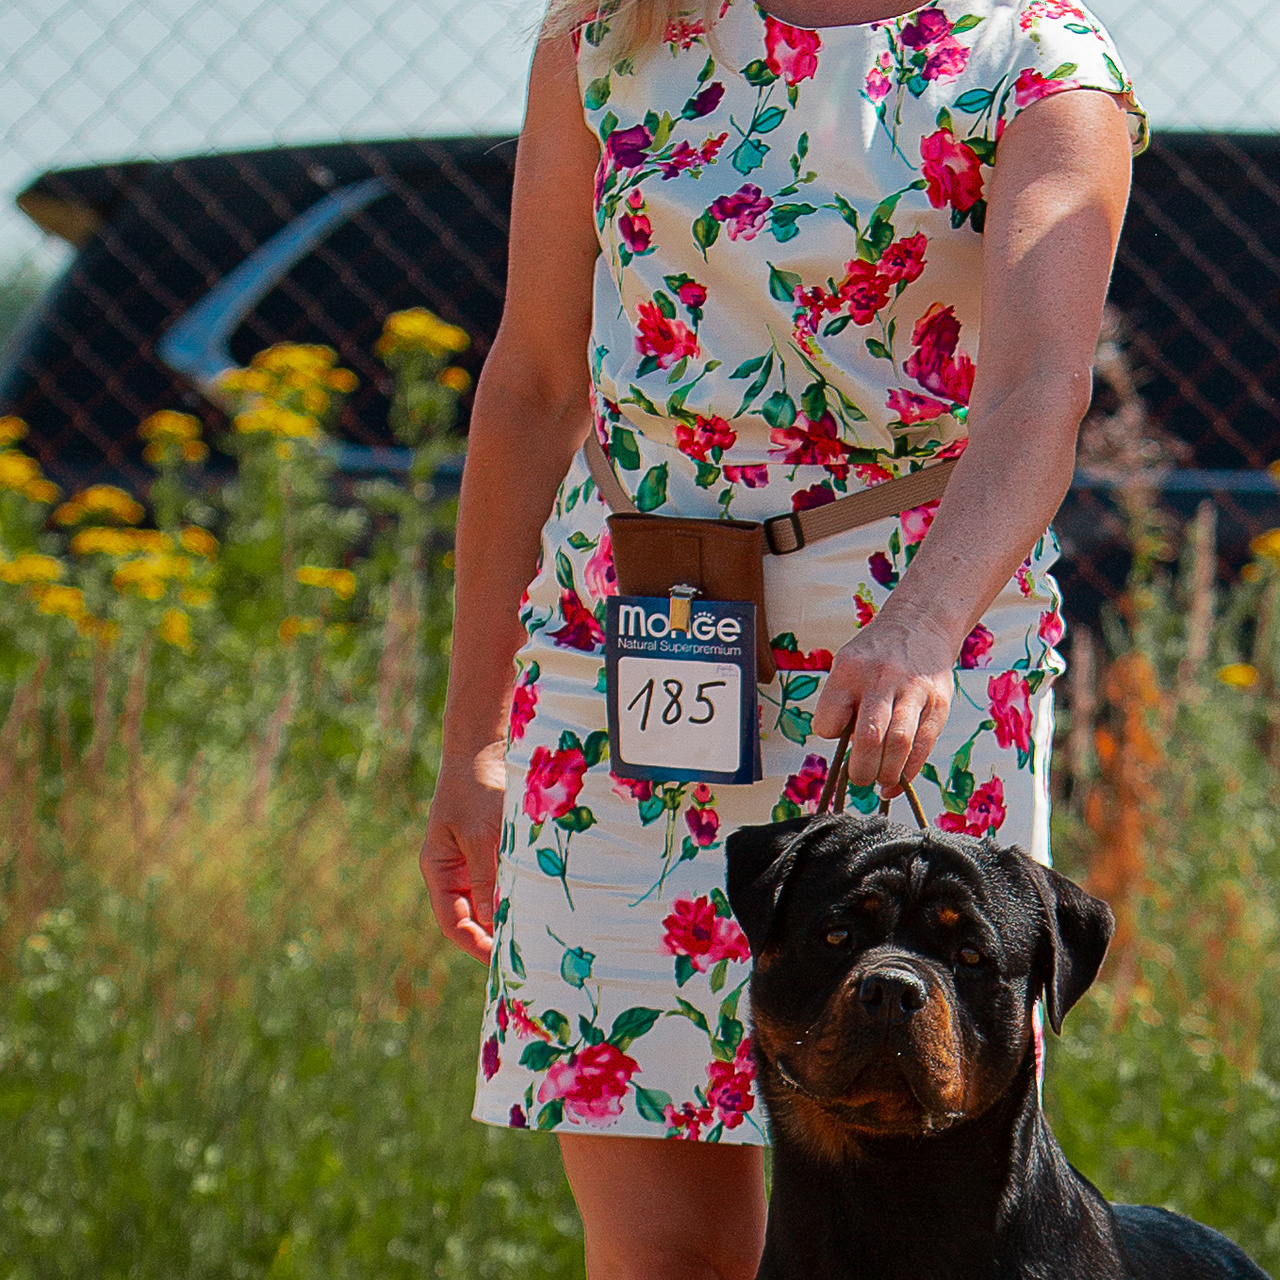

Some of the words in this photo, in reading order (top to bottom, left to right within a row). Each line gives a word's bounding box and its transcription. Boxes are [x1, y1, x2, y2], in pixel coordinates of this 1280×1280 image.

[618, 637, 657, 652] Natural
[660, 641, 742, 656] Superpremium
[627, 678, 727, 732] 185
